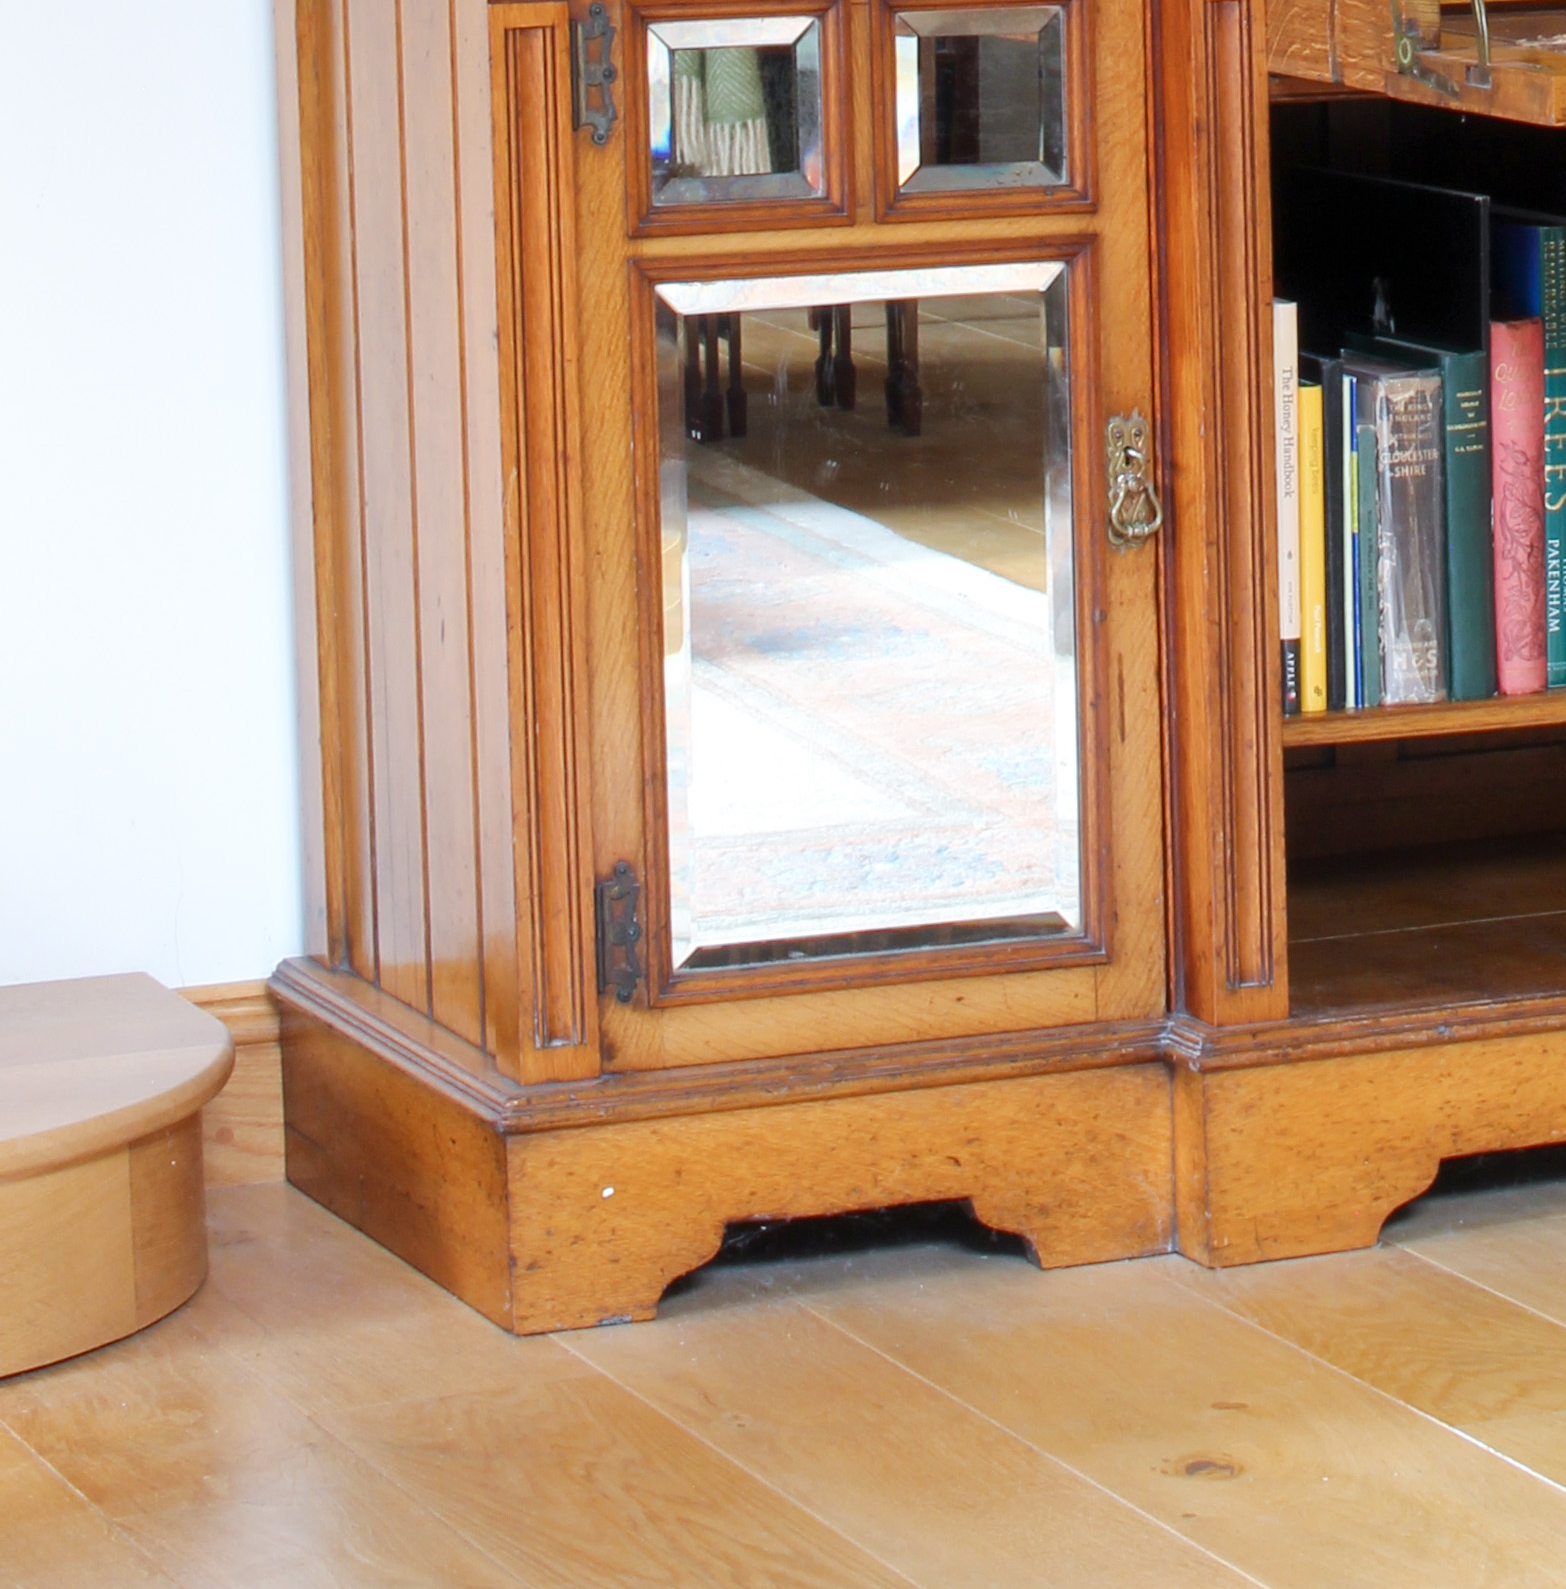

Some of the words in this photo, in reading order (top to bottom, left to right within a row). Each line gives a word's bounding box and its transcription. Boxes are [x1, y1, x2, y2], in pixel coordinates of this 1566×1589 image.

[1282, 367, 1293, 392] The
[1280, 394, 1295, 433] Honey
[1283, 437, 1295, 499] Handbook
[1547, 539, 1561, 633] PAKENHAM
